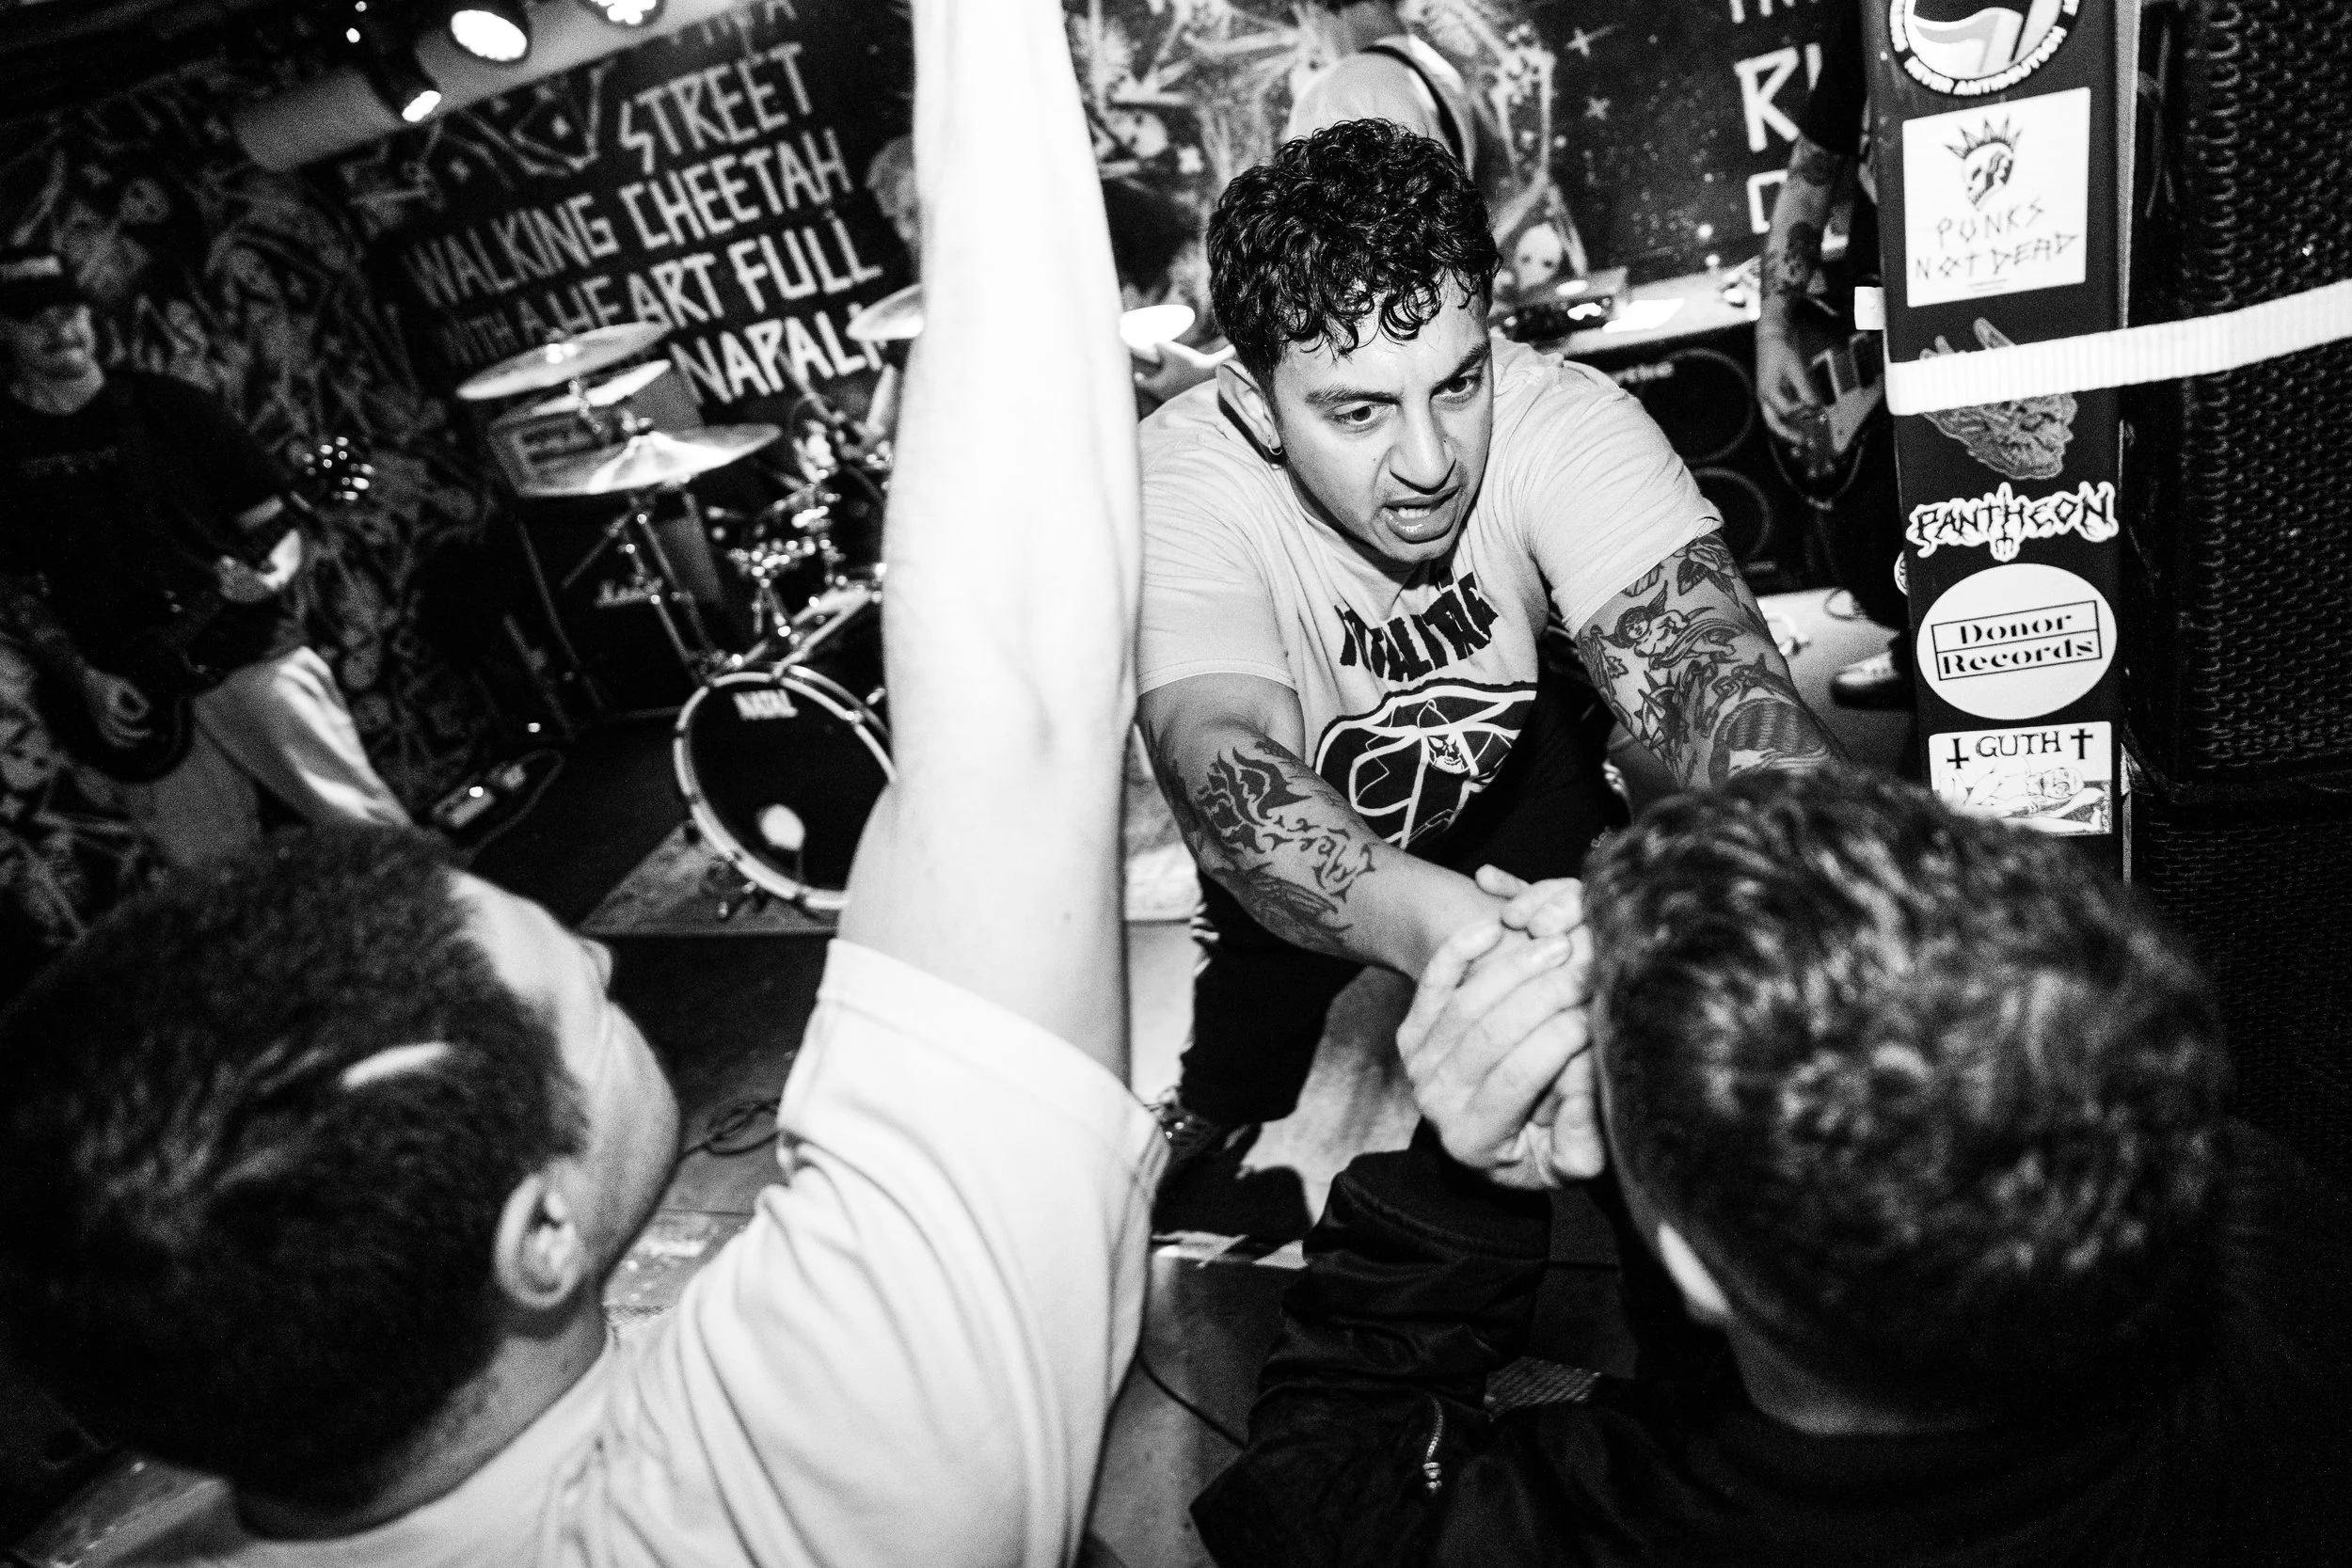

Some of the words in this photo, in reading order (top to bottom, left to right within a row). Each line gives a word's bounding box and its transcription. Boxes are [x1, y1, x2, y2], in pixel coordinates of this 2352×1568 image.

[617, 41, 812, 175] STREET
[405, 193, 621, 308] WALKING
[621, 127, 852, 251] CHEETAH
[1935, 196, 2045, 249] PUNKS
[727, 217, 882, 314] FULL
[1915, 252, 1981, 281] NOT
[1990, 232, 2080, 276] DEAD
[1915, 489, 2111, 557] PANTHEON
[1959, 612, 2073, 645] Donor
[1942, 639, 2094, 675] Records
[1976, 730, 2062, 758] GUTH
